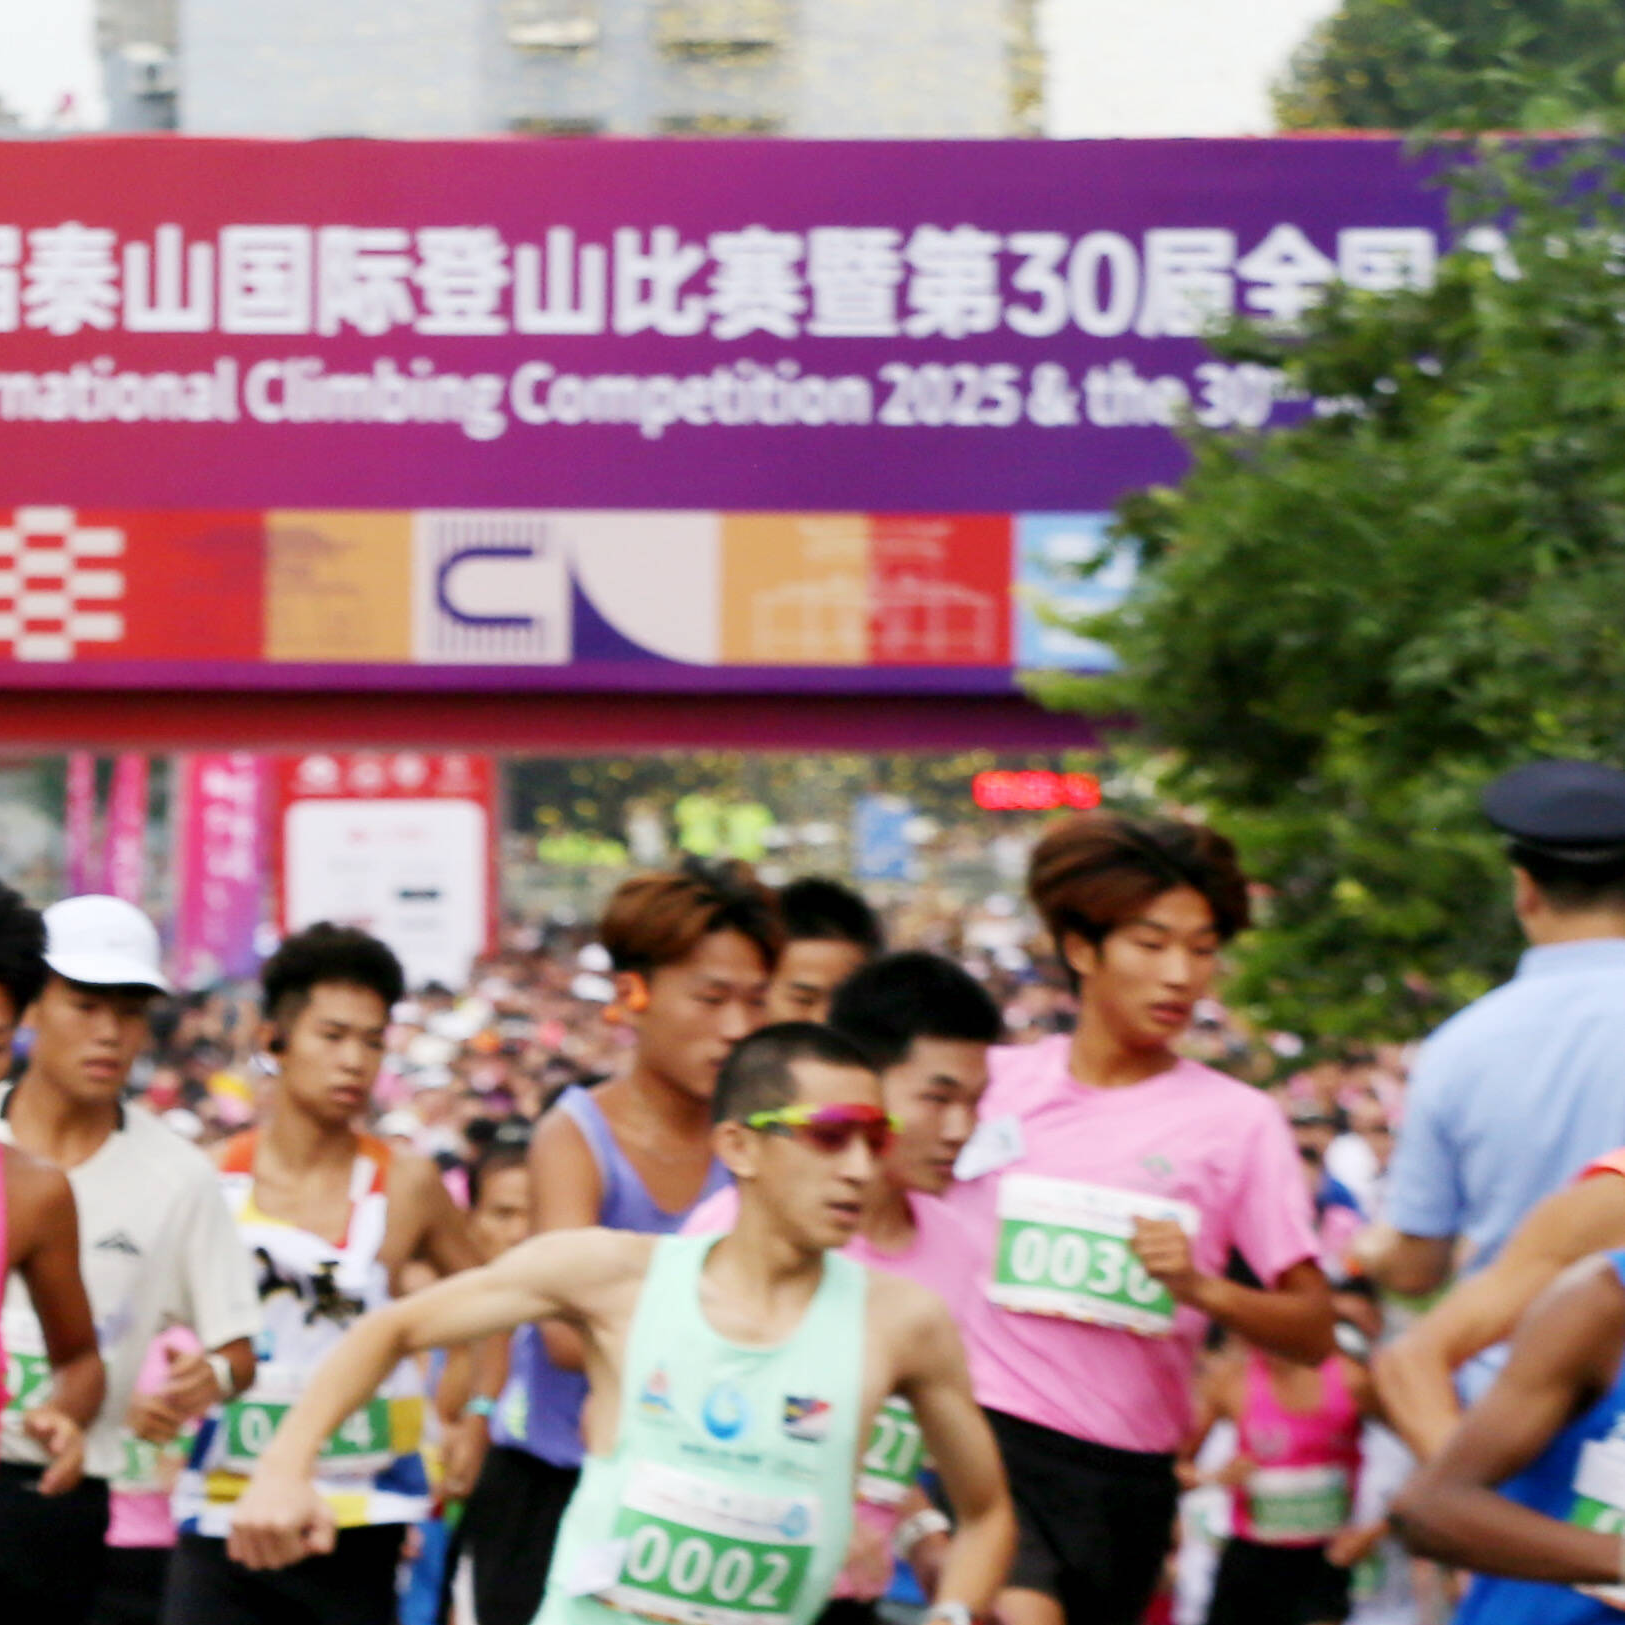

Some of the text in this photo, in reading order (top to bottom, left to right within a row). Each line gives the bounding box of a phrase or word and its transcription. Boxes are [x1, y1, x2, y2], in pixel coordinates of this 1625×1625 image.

[245, 357, 506, 440] Climbing
[511, 357, 872, 440] Competition
[878, 361, 1021, 427] 2025
[1026, 361, 1081, 428] &
[1085, 361, 1191, 428] the
[1194, 360, 1309, 428] 30
[238, 1406, 375, 1454] 04
[862, 1413, 923, 1476] 27
[626, 1523, 791, 1608] 0002
